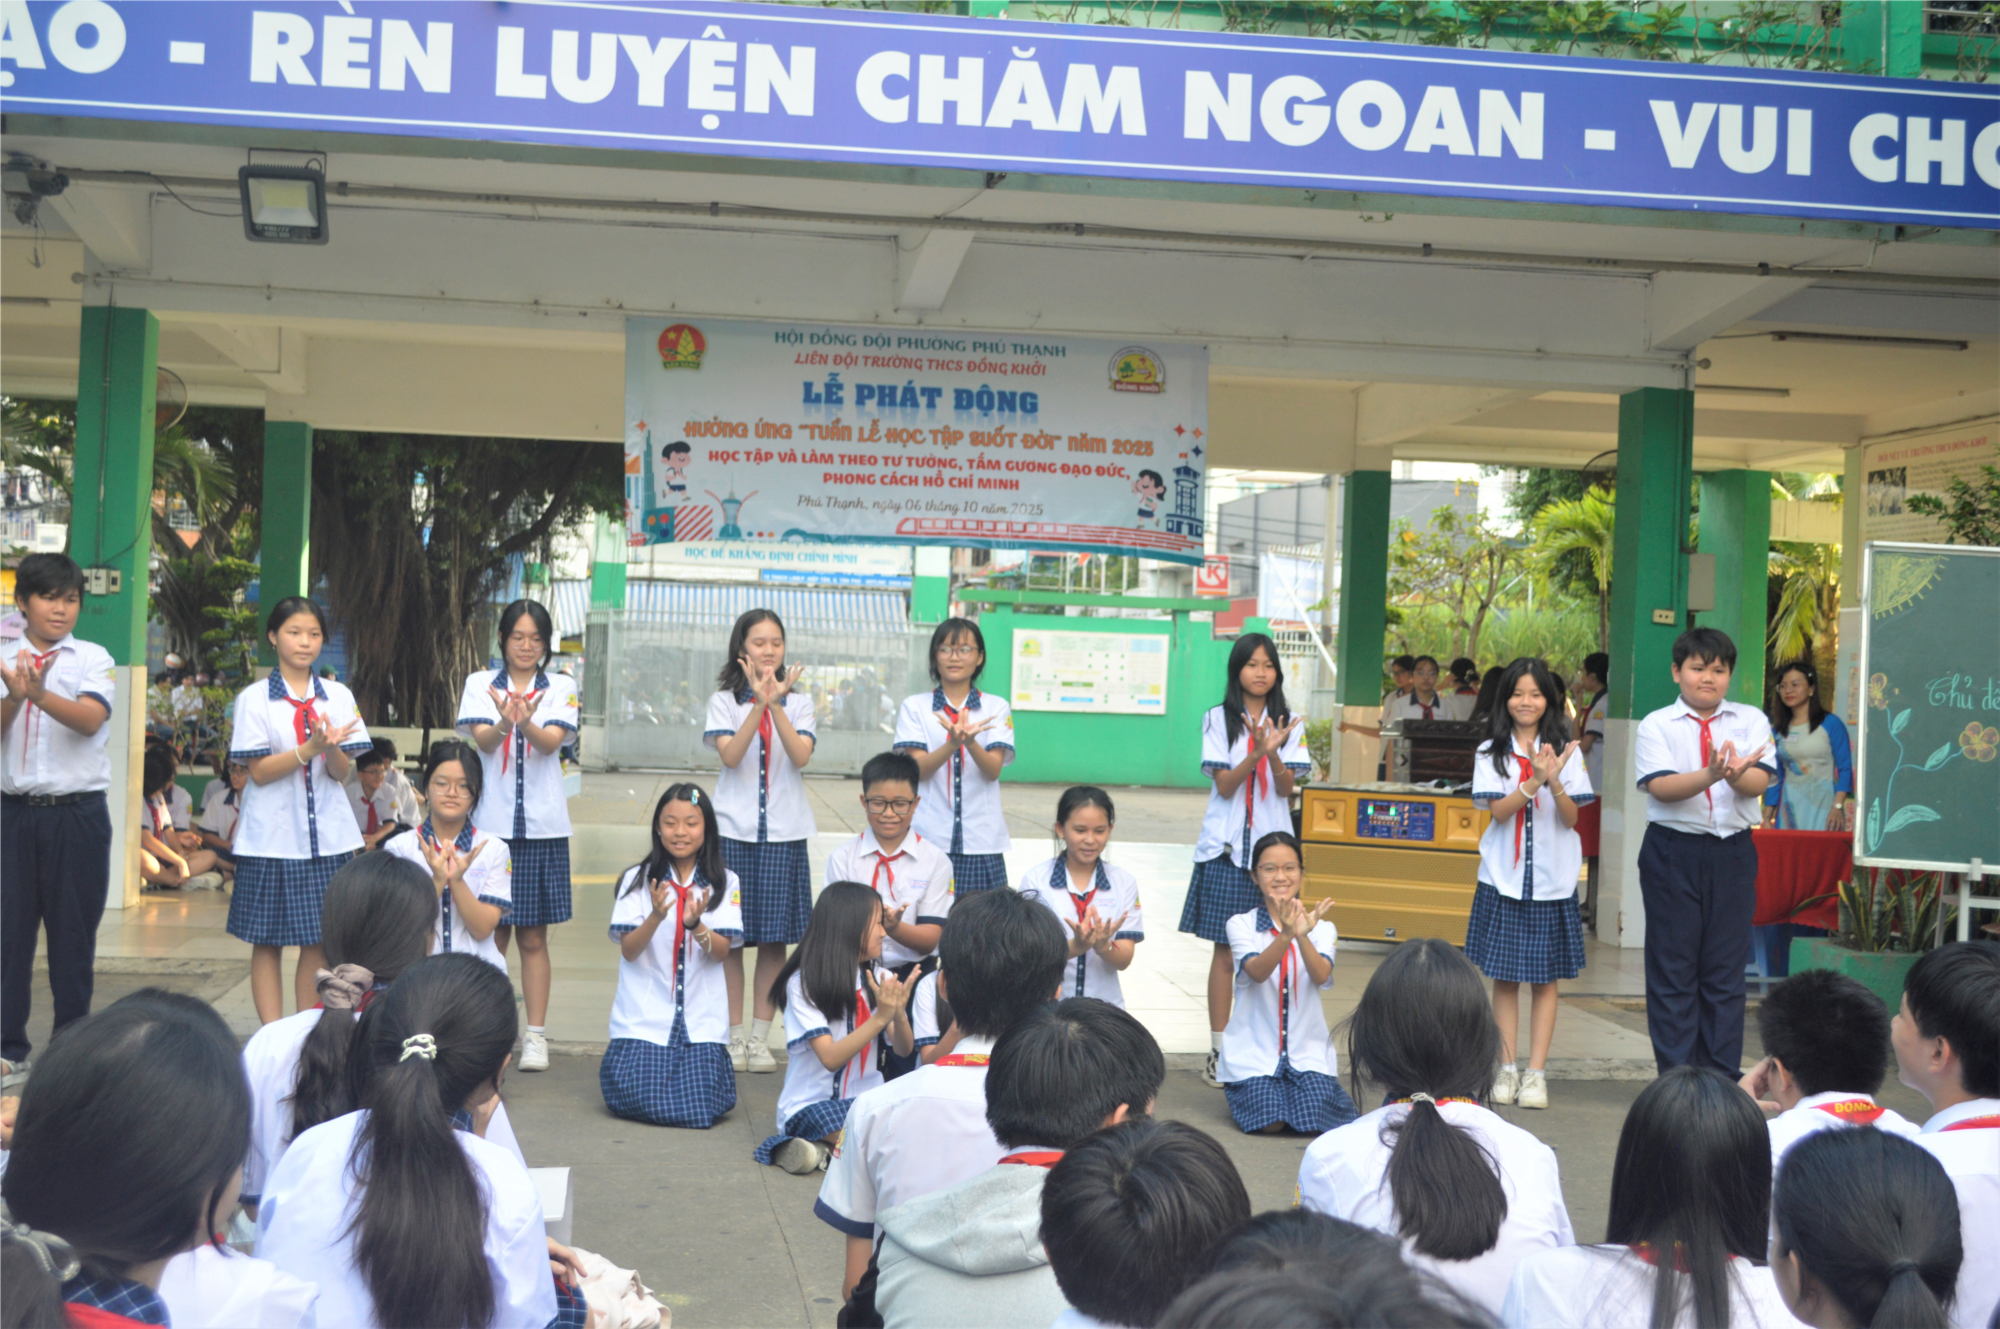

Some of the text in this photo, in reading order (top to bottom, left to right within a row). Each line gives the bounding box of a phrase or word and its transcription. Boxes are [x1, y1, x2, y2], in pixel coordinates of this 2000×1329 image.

[250, 0, 453, 93] RÈN
[495, 25, 816, 131] LUYỆN
[855, 46, 1147, 136] CHĂM
[1184, 70, 1544, 160] NGOAN
[1649, 99, 1812, 176] VUI
[775, 328, 1067, 359] HỘI ĐỒNG ĐỘI PHƯỜNG PHÚ THẠNH
[795, 350, 1047, 376] LIÊN ĐỘI TRƯỜNG THCS ĐỒNG KHỞI
[802, 372, 1039, 417] LỄ PHÁT ĐỘNG
[683, 416, 749, 439] HƯỞNG
[755, 417, 793, 439] ỨNG
[858, 419, 882, 443] LỄ
[884, 427, 926, 448] HỌC
[929, 425, 964, 449] TẬP
[969, 425, 1018, 448] SUỐT
[1112, 439, 1154, 457] 2025
[708, 448, 1131, 480] HỌC TẬP VÀ LÀM THEO TƯ TƯỞNG, TẤM GƯƠNG ĐẠO ĐỨC,
[823, 470, 1019, 490] PHONG CÁCH HỒ CHÍ MINH
[797, 494, 1044, 516] Phú Thạnh, ngày 06 tháng 10 năm 2025
[685, 547, 707, 560] HỌC
[769, 550, 795, 563] ĐỊNH
[797, 549, 830, 563] CHÍNH
[832, 550, 858, 564] MÌNH
[1925, 673, 1974, 710] Chủ
